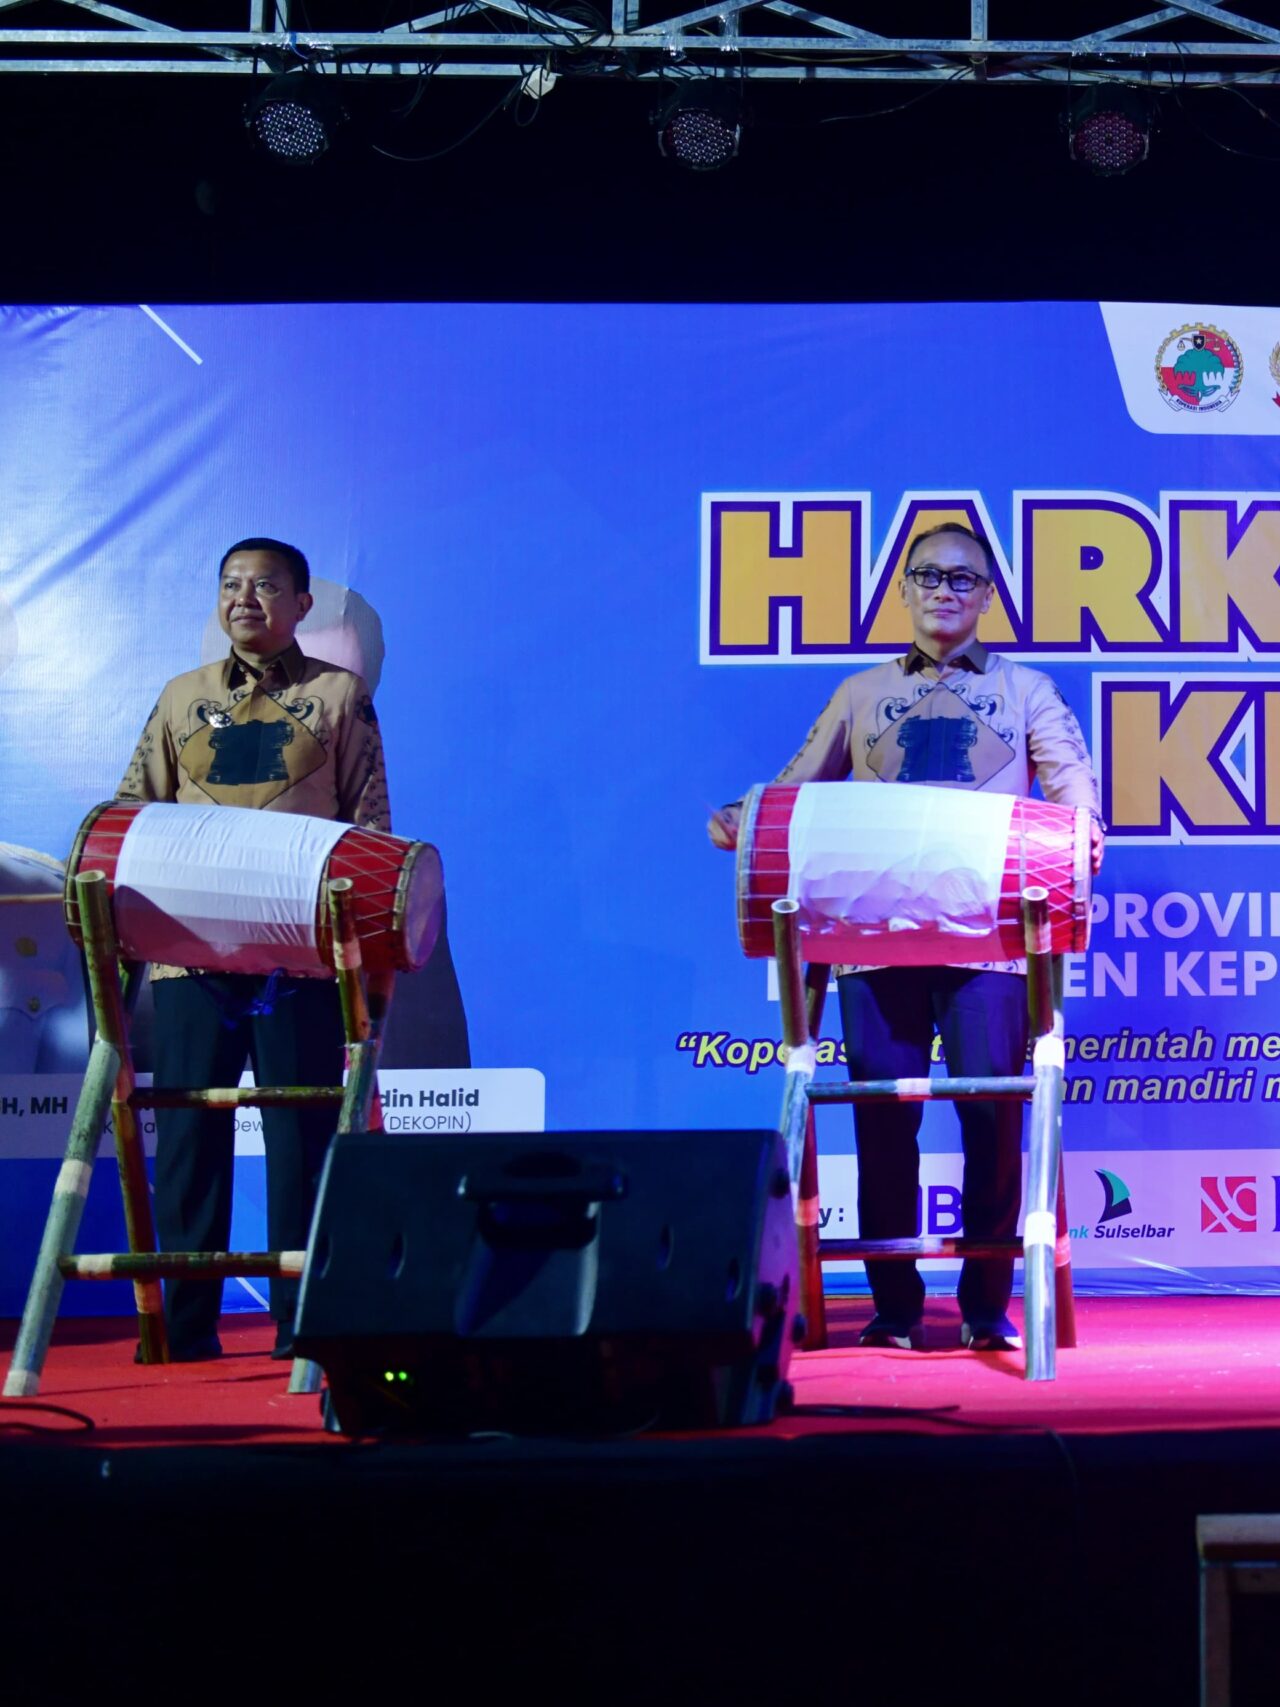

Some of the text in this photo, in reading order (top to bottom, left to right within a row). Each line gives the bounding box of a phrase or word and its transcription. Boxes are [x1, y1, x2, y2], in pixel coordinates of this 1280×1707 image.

[1106, 1069, 1254, 1101] mandiri
[31, 1097, 68, 1114] MH
[419, 1088, 479, 1107] Halid
[383, 1111, 471, 1133] (DEKOPIN)
[1094, 1224, 1175, 1239] Sulselbar
